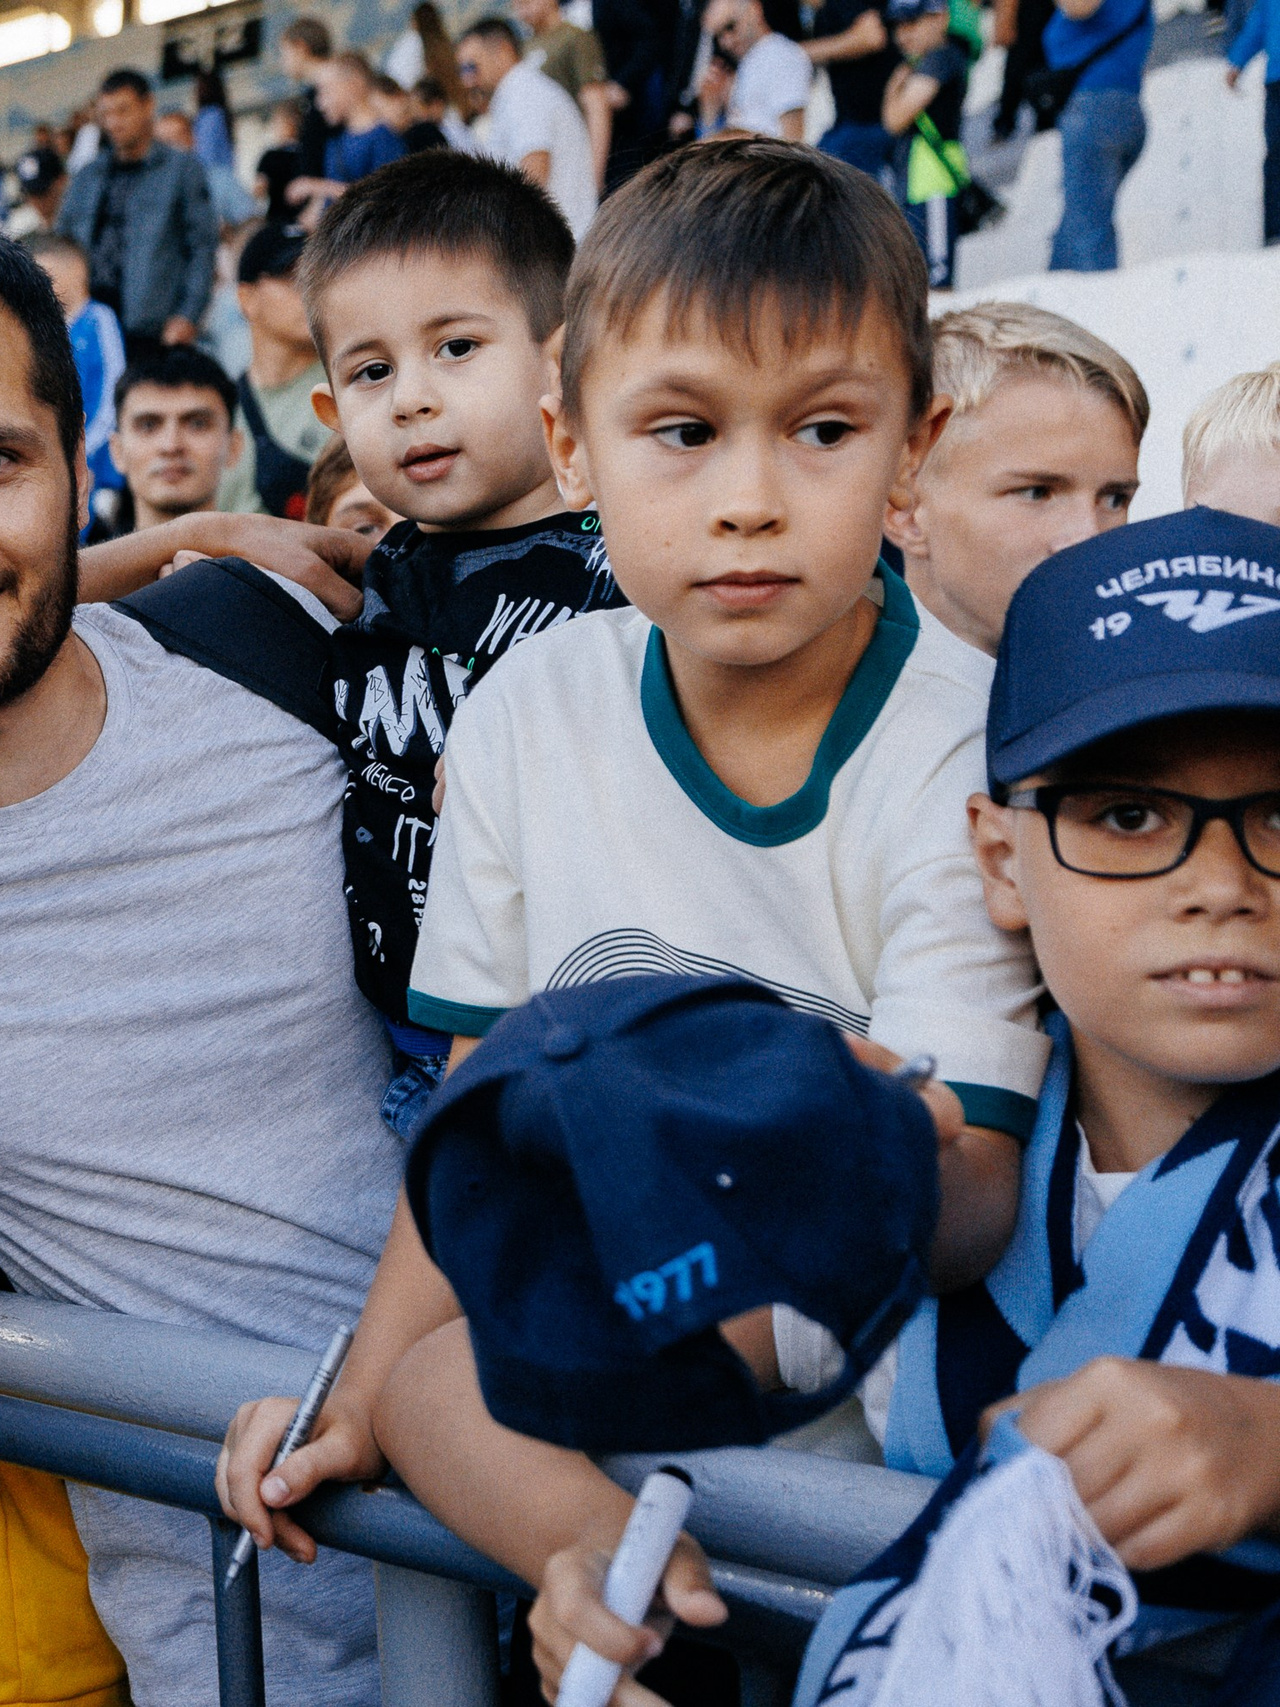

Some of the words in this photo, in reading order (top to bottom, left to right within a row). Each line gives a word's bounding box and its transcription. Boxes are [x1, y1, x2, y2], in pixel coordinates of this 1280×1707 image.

[1095, 555, 1280, 599] ЧЕЛЯБИН
[1088, 611, 1132, 641] 19
[613, 1241, 718, 1321] 1977
